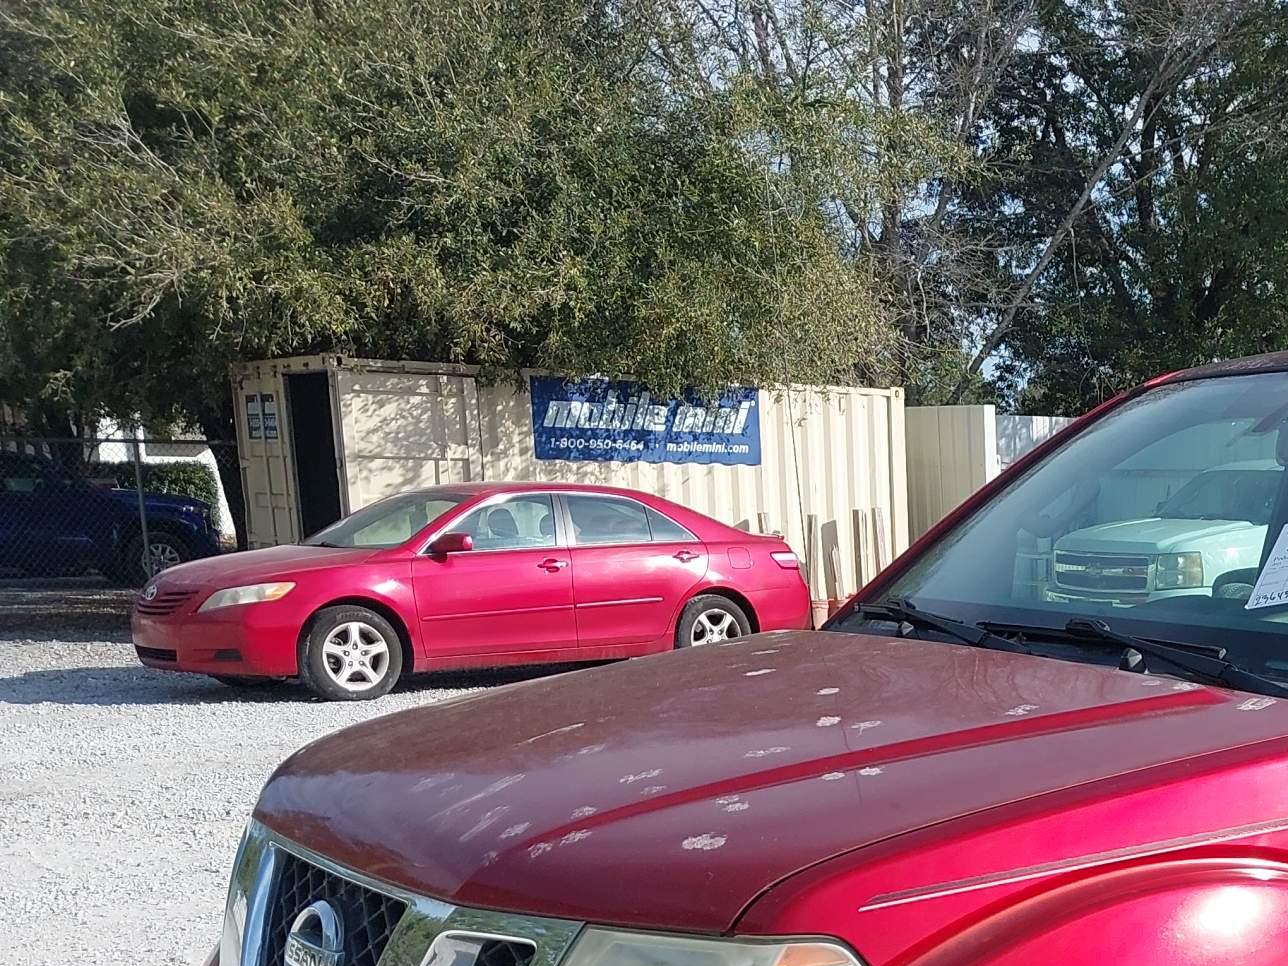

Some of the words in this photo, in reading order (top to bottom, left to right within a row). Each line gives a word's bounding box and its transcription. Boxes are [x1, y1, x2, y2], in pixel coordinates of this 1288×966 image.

[543, 390, 667, 432] mobile
[672, 401, 750, 434] mini
[550, 438, 644, 450] 1-800-950-6464
[666, 442, 749, 454] mobilemini.com
